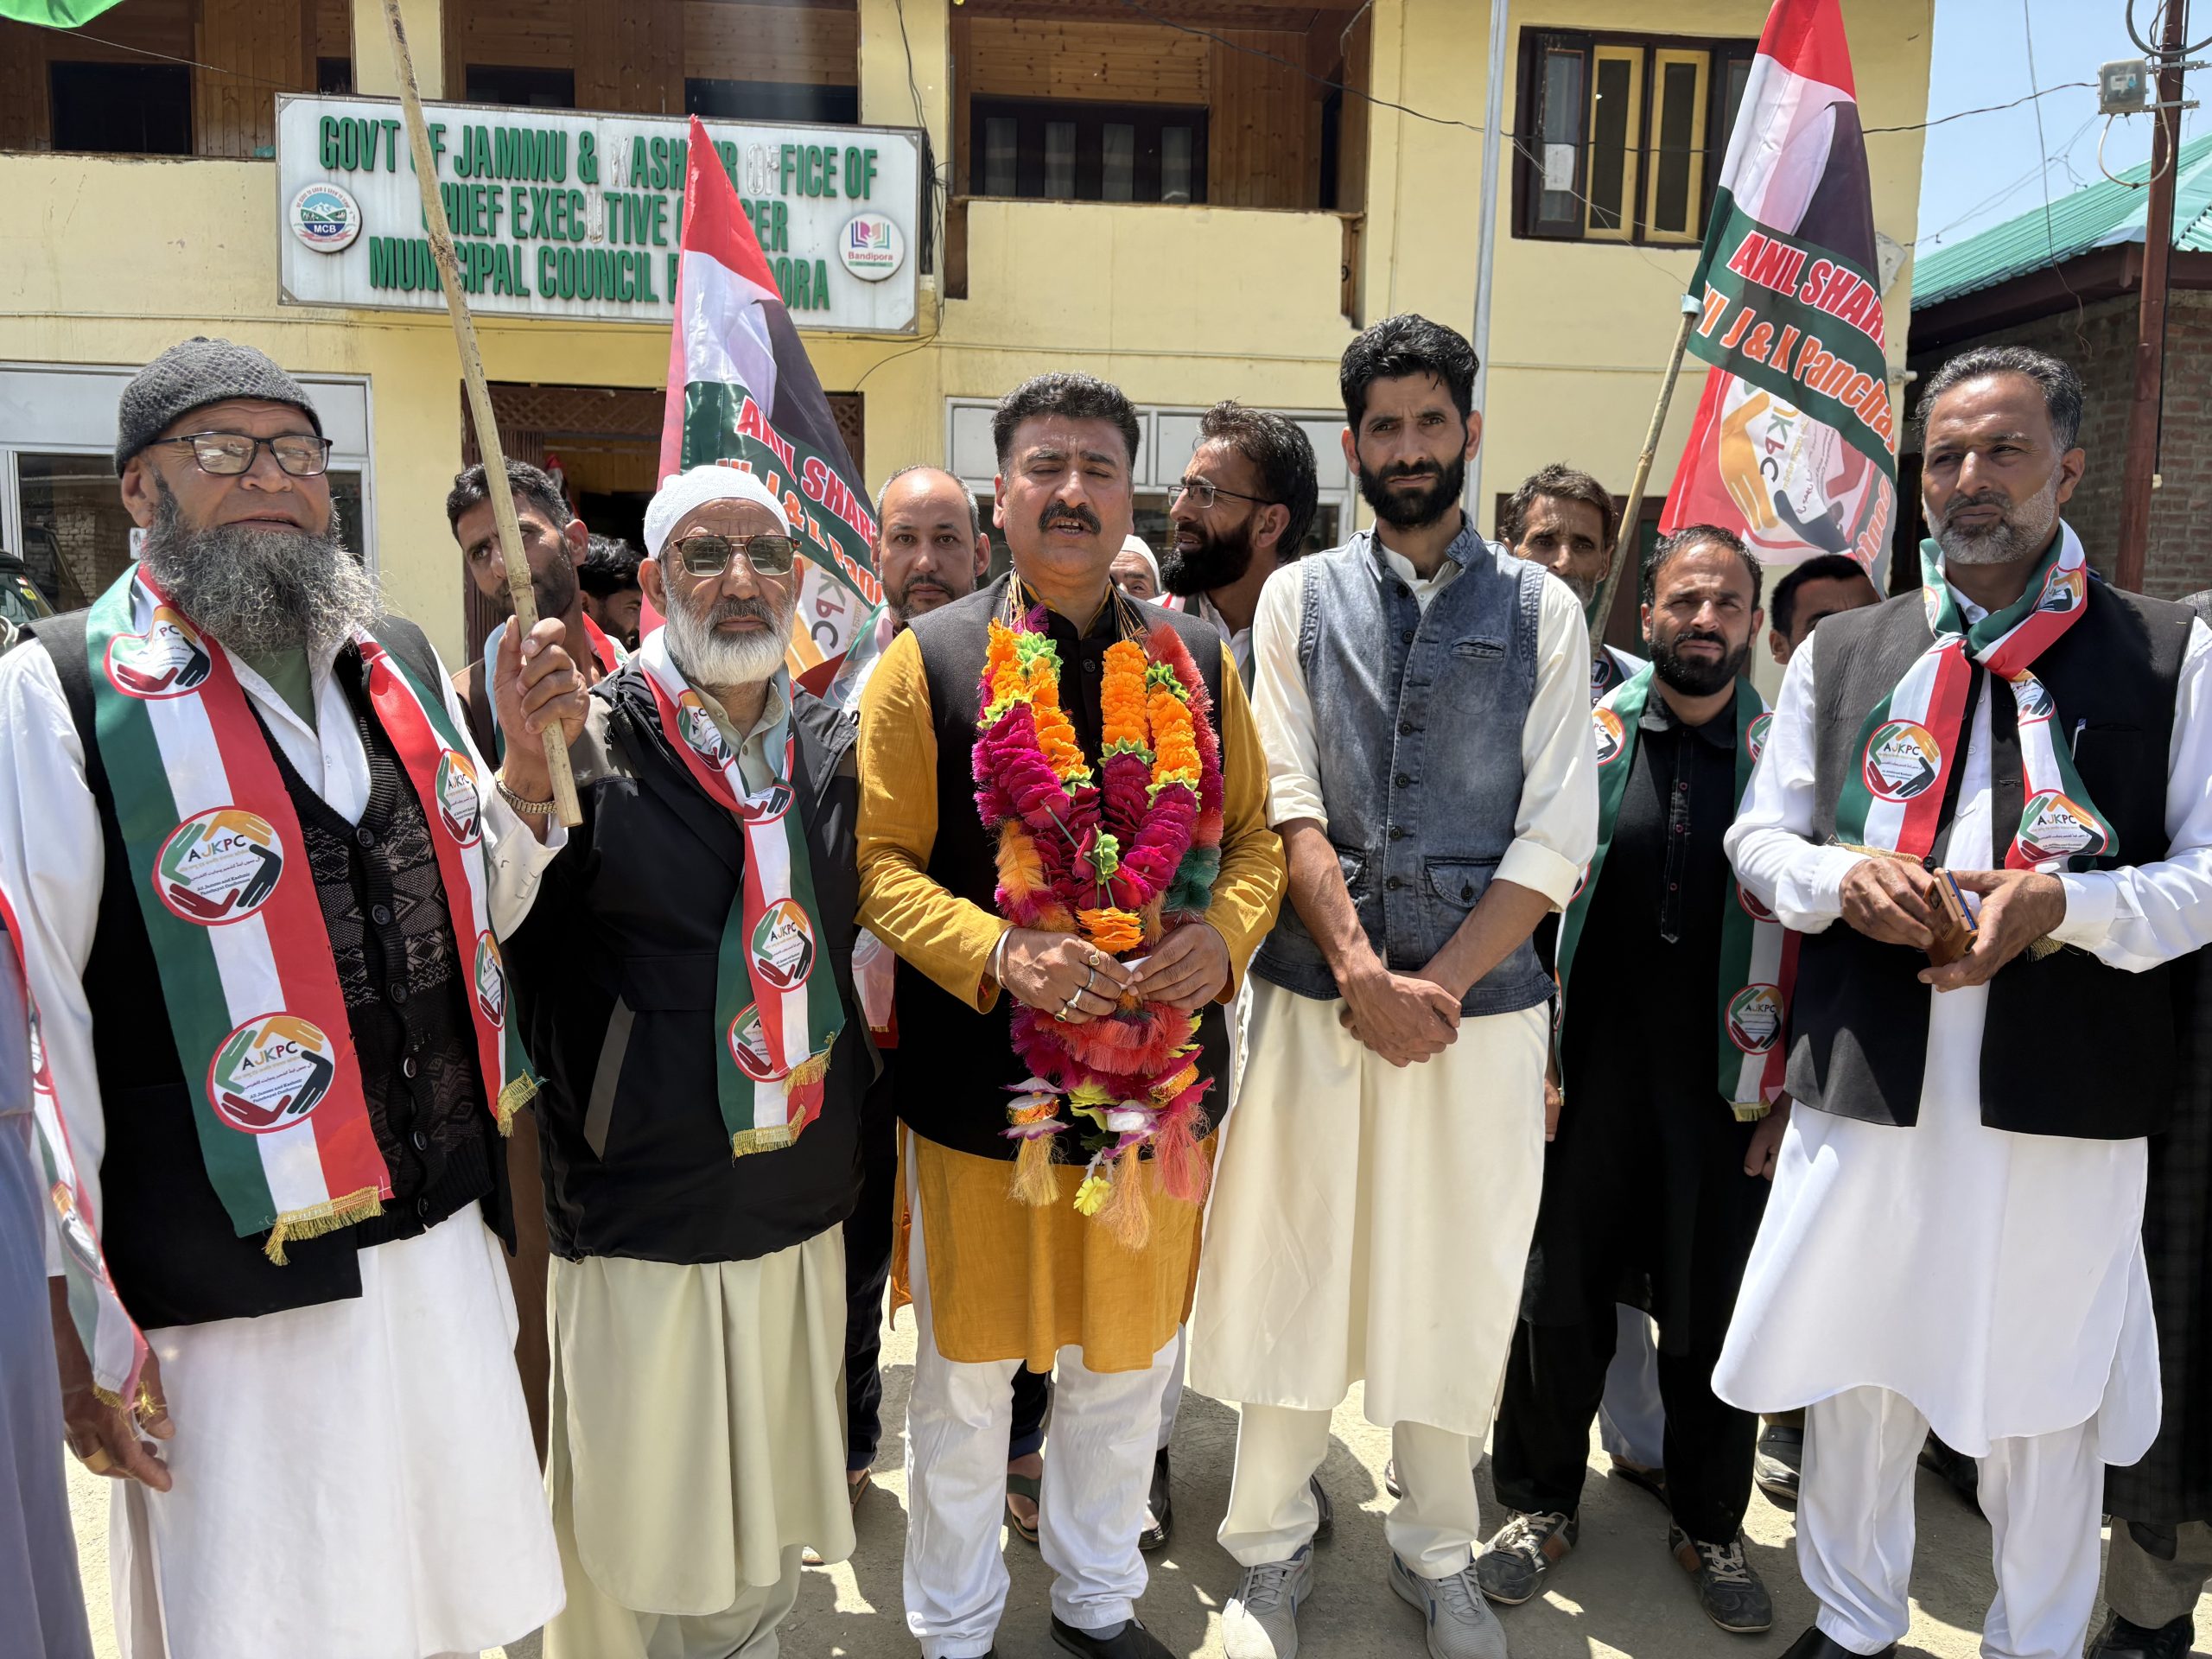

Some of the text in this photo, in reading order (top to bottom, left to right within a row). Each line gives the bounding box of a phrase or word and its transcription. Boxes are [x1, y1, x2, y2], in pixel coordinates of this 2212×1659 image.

[320, 116, 401, 173] GOVT
[453, 124, 568, 183] JAMMU
[577, 130, 600, 184] &
[611, 136, 739, 194] KASHR
[844, 146, 878, 200] OF
[422, 181, 504, 238] HIEF
[511, 186, 668, 247] EXECUTIVE
[369, 236, 531, 297] MUNCIPAL
[537, 245, 659, 303] COUNCIL
[848, 251, 893, 261] Bandipora
[1726, 229, 1886, 359] ANIL SHAR
[1719, 306, 1757, 349] J
[1742, 321, 1775, 364] &
[1768, 324, 1802, 374] K
[1793, 334, 1895, 455] Pancha
[734, 395, 877, 550] ANIL SHAR
[1884, 742, 1921, 756] AJKPC
[2037, 814, 2077, 826] AJKPC
[188, 834, 246, 862] AJKPC
[771, 921, 797, 942] AJKPC
[1745, 1004, 1777, 1013] AJKPC
[242, 1040, 298, 1071] AJKPC
